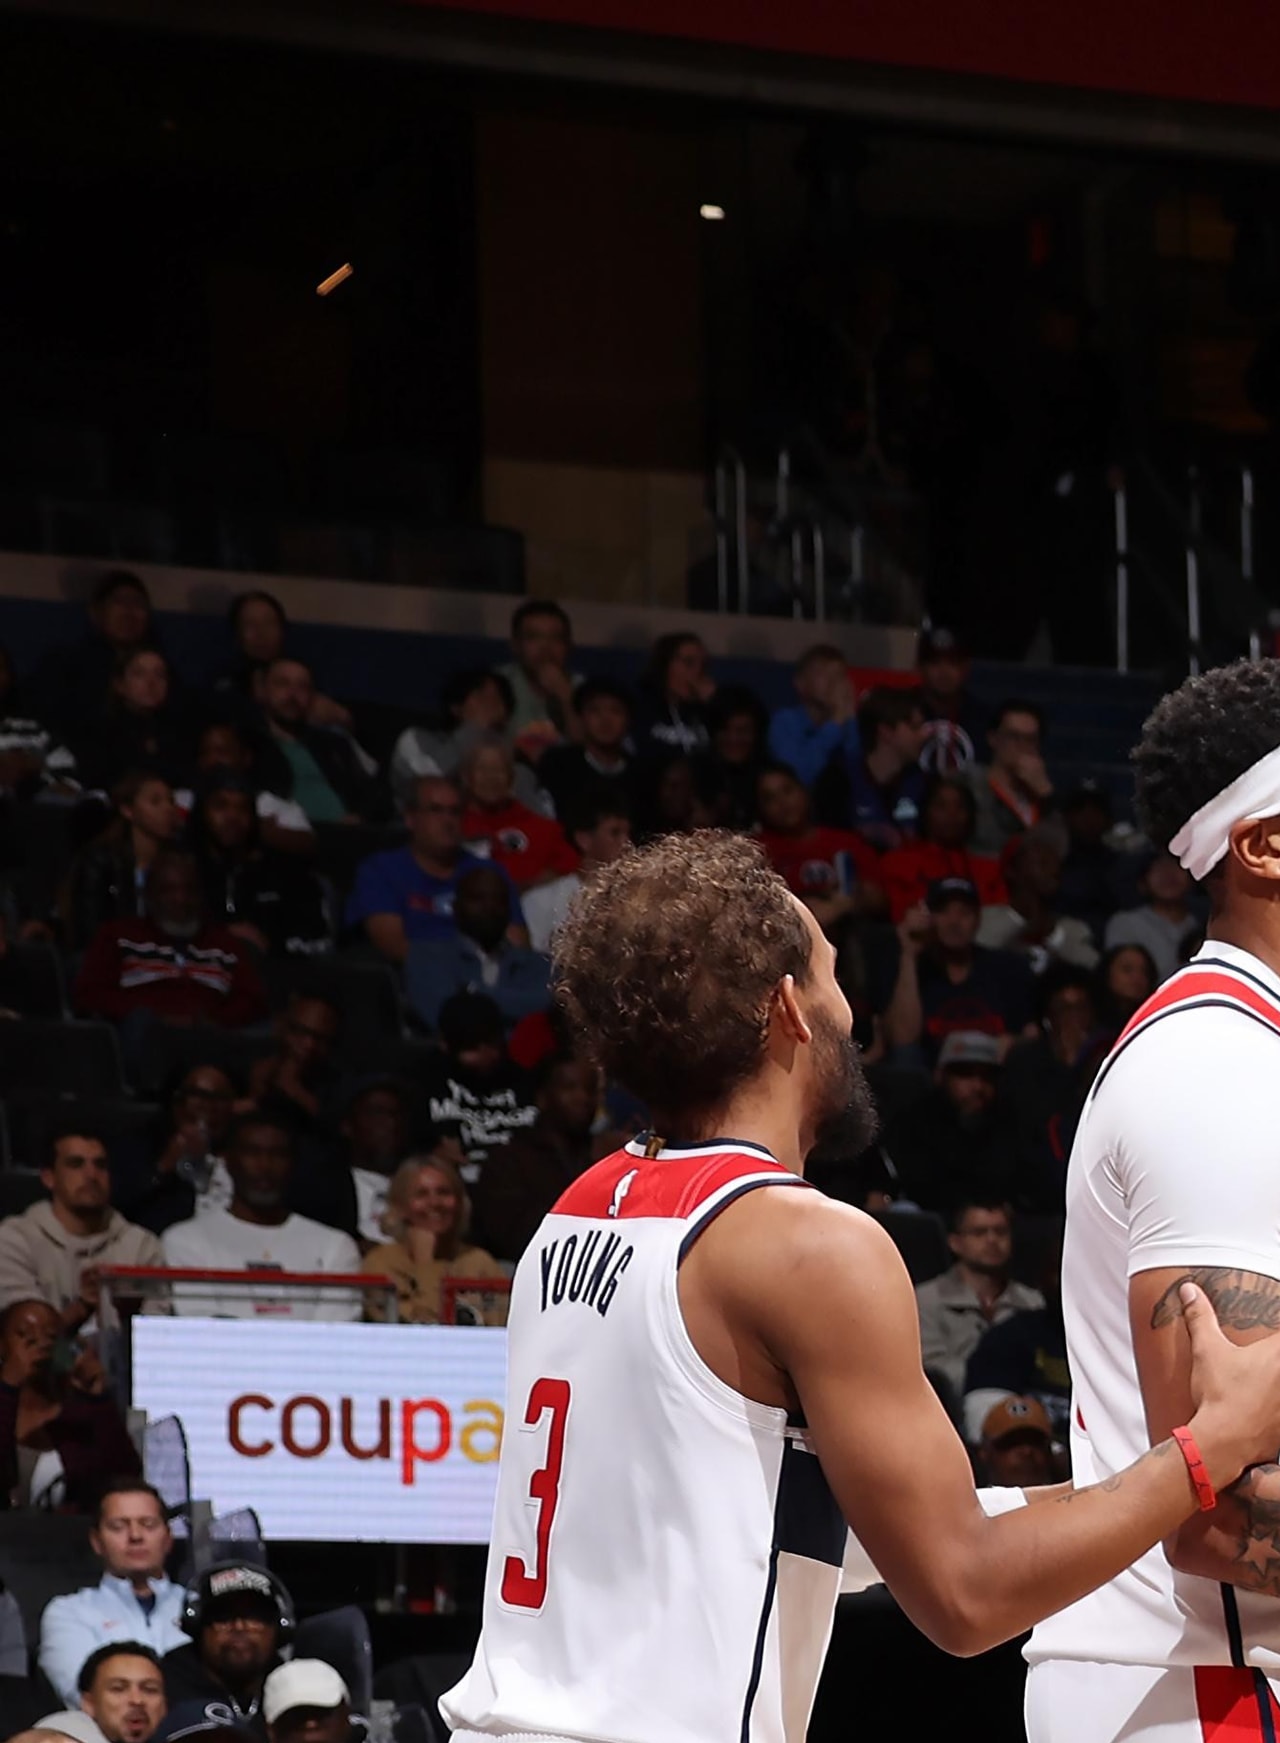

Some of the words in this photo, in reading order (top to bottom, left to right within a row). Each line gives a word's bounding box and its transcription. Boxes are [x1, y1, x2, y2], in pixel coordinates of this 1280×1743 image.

[541, 1230, 634, 1317] YOUNG
[227, 1393, 504, 1486] coupa
[500, 1376, 572, 1609] 3
